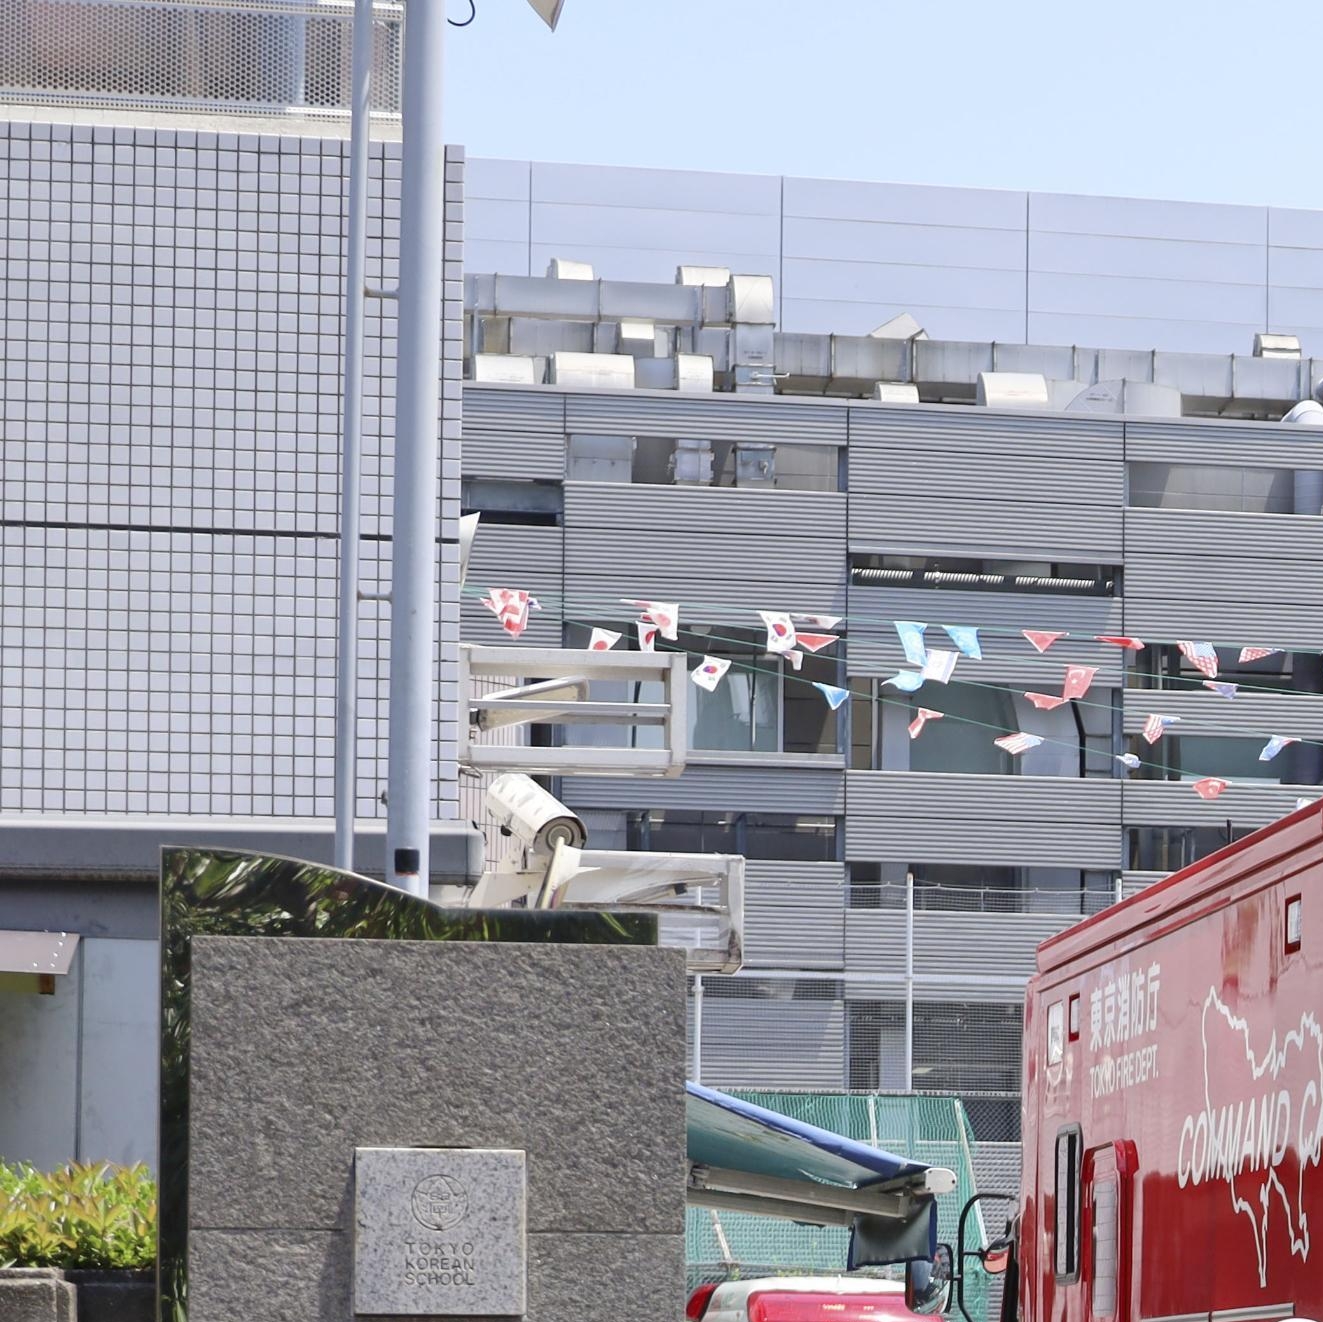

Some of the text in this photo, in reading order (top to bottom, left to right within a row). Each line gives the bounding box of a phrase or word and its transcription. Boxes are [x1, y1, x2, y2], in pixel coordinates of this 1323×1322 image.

[1089, 961, 1160, 1052] 東京消防庁
[1089, 1044, 1159, 1101] TOKYO FIRE DEPT.
[1178, 1090, 1291, 1188] COMMAND
[404, 1242, 474, 1255] TOKYO
[405, 1257, 474, 1270] KOREAN
[404, 1272, 475, 1285] SCHOOL
